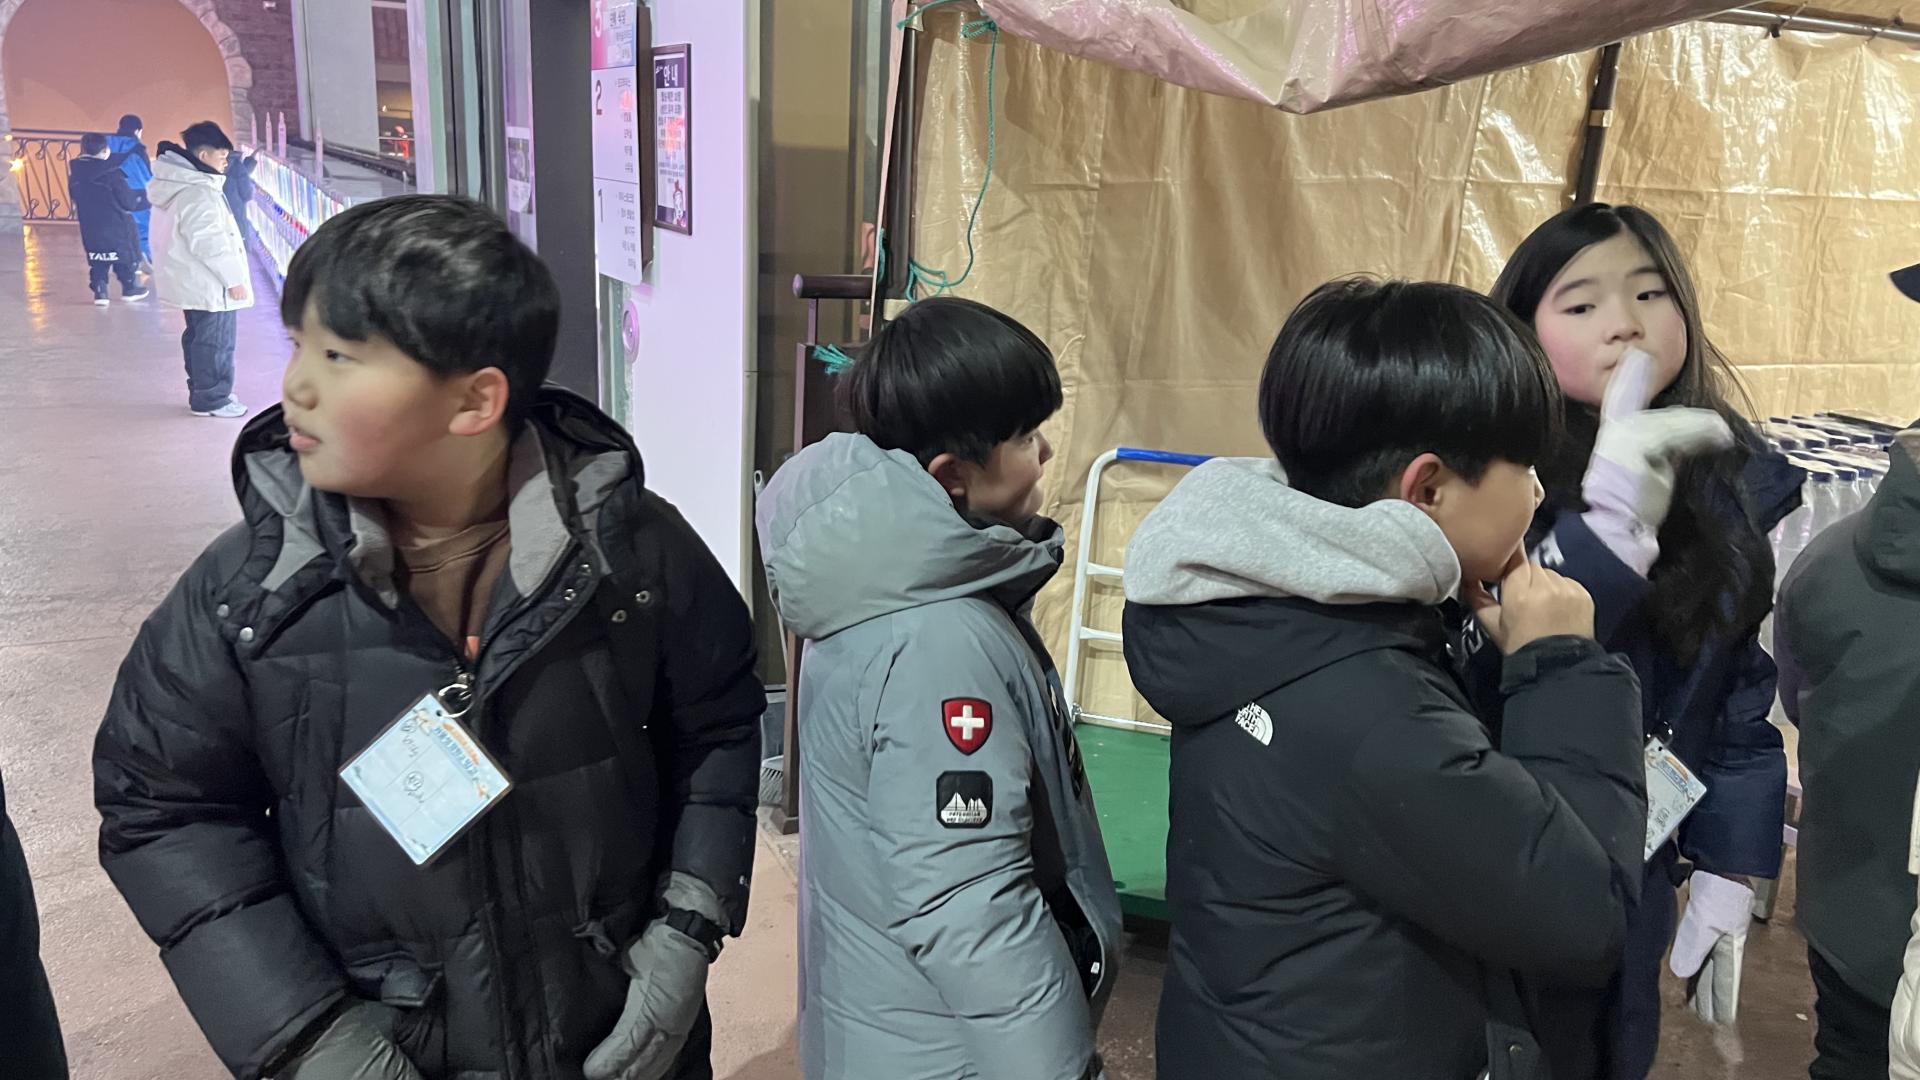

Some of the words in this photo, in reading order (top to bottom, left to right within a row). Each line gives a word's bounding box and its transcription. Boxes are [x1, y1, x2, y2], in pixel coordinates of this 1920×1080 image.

[663, 64, 679, 87] 안내
[595, 79, 603, 116] 2
[598, 188, 604, 223] 1
[88, 252, 119, 261] YALE
[1235, 714, 1256, 733] FACE
